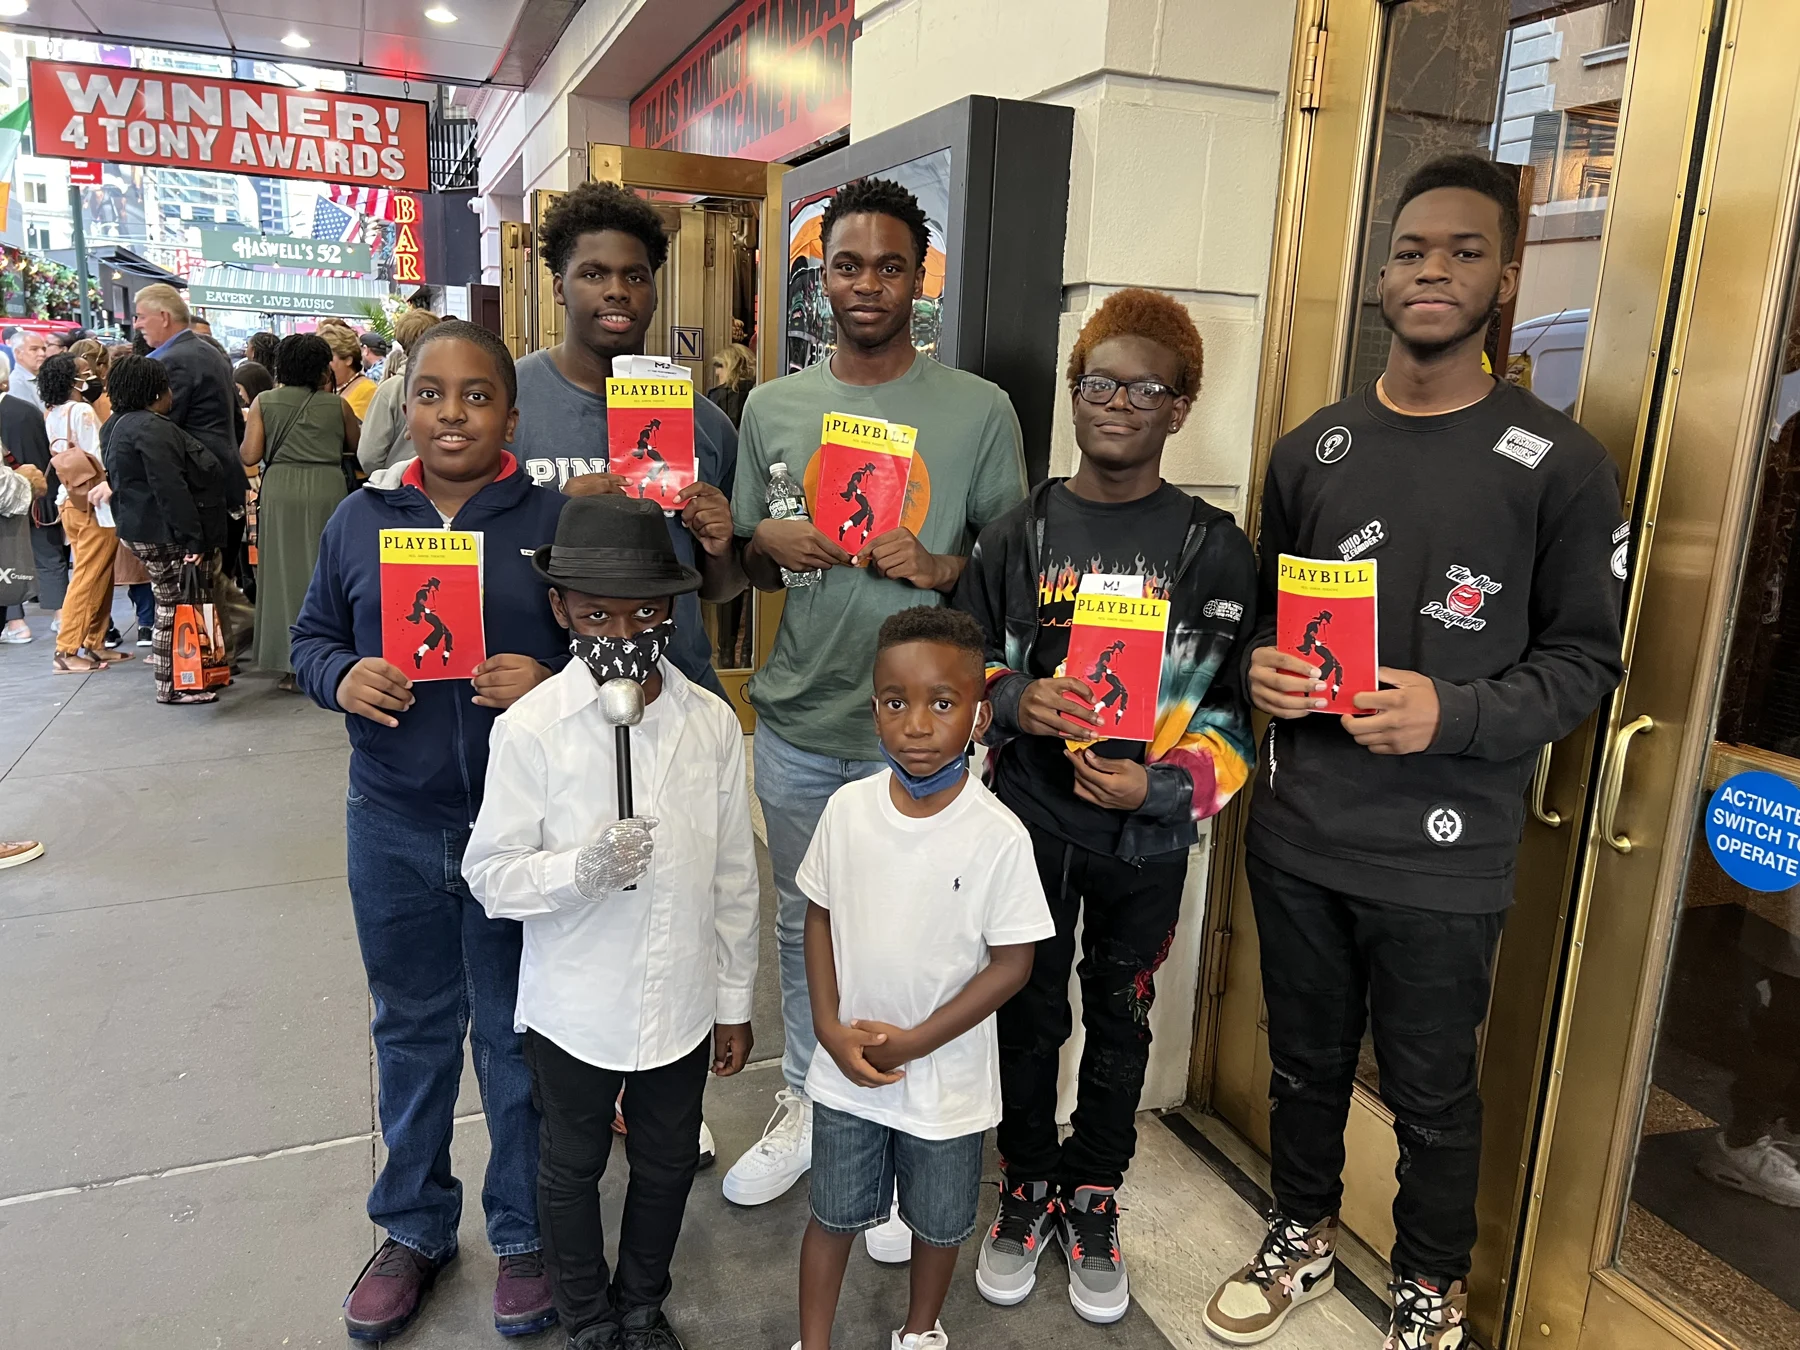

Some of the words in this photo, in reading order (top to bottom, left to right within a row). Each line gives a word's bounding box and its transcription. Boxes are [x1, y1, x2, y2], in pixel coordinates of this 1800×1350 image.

[665, 78, 679, 136] IS
[682, 23, 742, 122] TAKING
[56, 71, 400, 146] WINNER!
[61, 115, 89, 149] 4
[98, 118, 218, 161] TONY
[230, 131, 405, 180] AWARDS
[393, 195, 420, 280] BAR
[317, 244, 342, 263] 52
[206, 291, 254, 304] EATERY
[263, 295, 291, 307] LIVE
[293, 297, 335, 309] MUSIC
[676, 332, 698, 355] N
[611, 384, 688, 396] PLAYBILL
[832, 419, 910, 444] PLAYBILL
[384, 536, 472, 550] PLAYBILL
[1281, 563, 1368, 583] PLAYBILL
[1077, 599, 1161, 617] PLAYBILL
[1721, 787, 1800, 826] ACTIVATE
[1713, 808, 1782, 845] SWITCH
[1716, 834, 1799, 877] OPERATE
